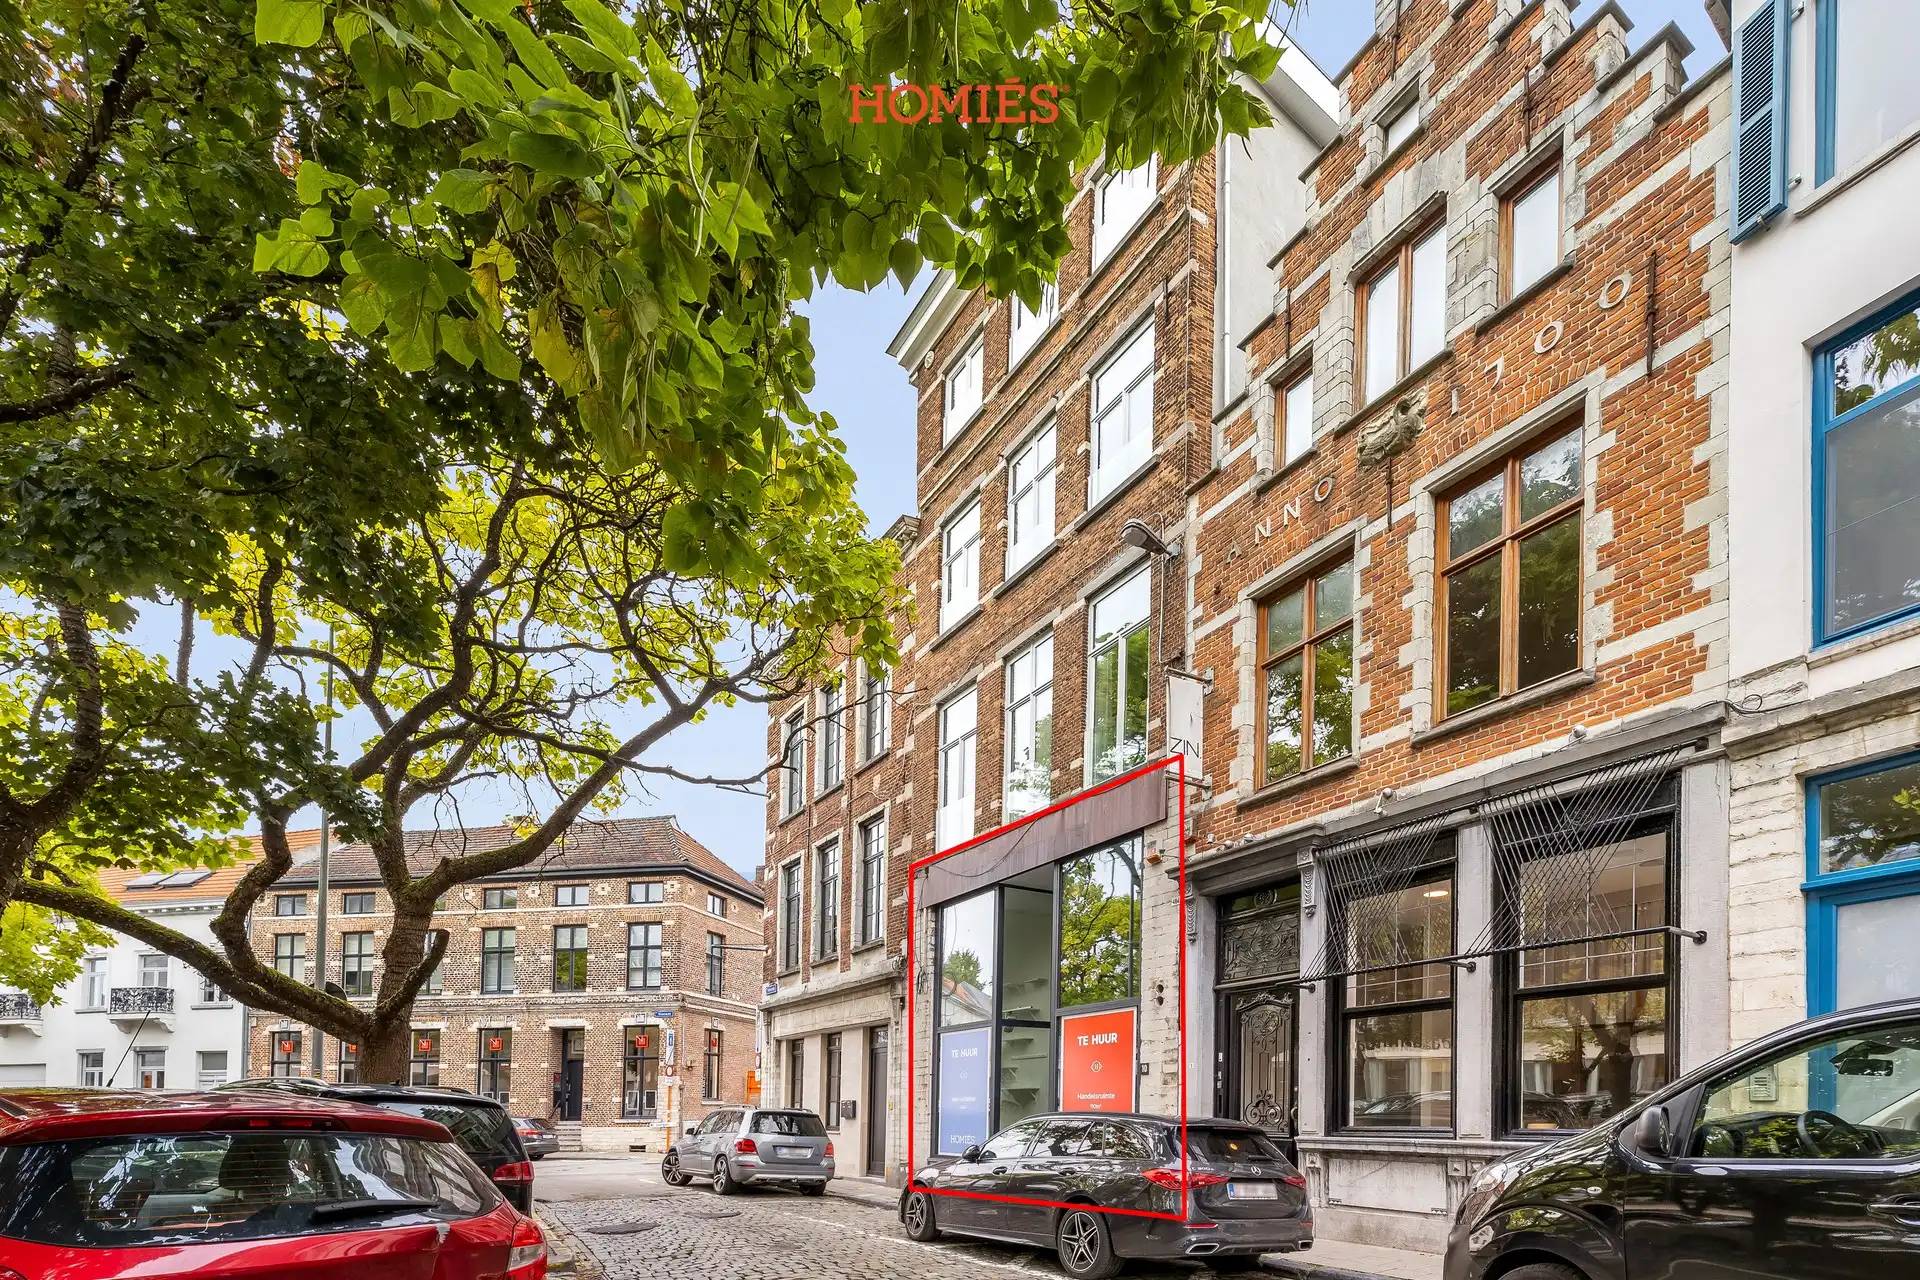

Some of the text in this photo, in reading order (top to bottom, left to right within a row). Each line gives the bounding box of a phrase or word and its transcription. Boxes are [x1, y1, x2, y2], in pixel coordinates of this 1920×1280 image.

[1226, 476, 1336, 564] ANNO
[1077, 1032, 1118, 1046] TE HUUR
[951, 1047, 978, 1058] TE HUUR
